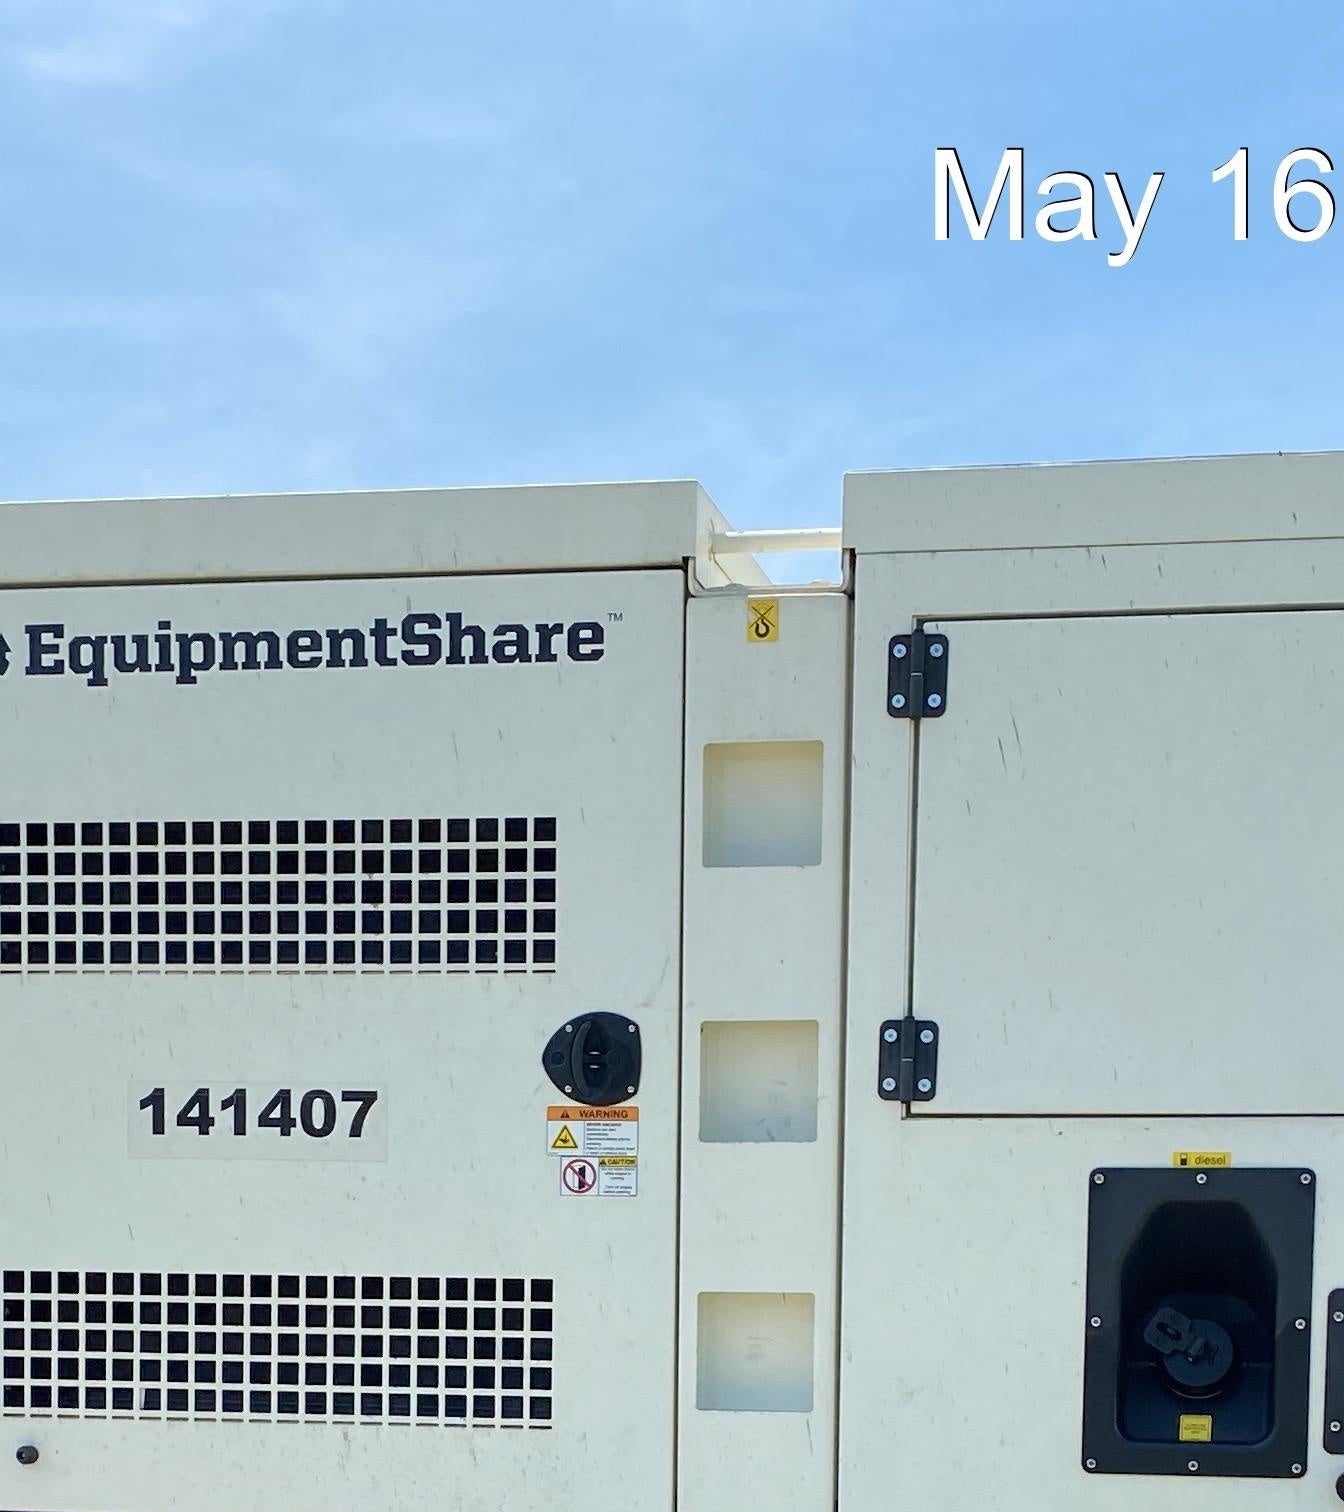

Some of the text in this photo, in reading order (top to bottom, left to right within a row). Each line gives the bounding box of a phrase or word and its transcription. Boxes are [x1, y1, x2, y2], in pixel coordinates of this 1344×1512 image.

[24, 611, 605, 687] EquipmentShare
[139, 1087, 378, 1138] 141407
[579, 1109, 629, 1119] WARNING
[1194, 1155, 1226, 1166] diesel
